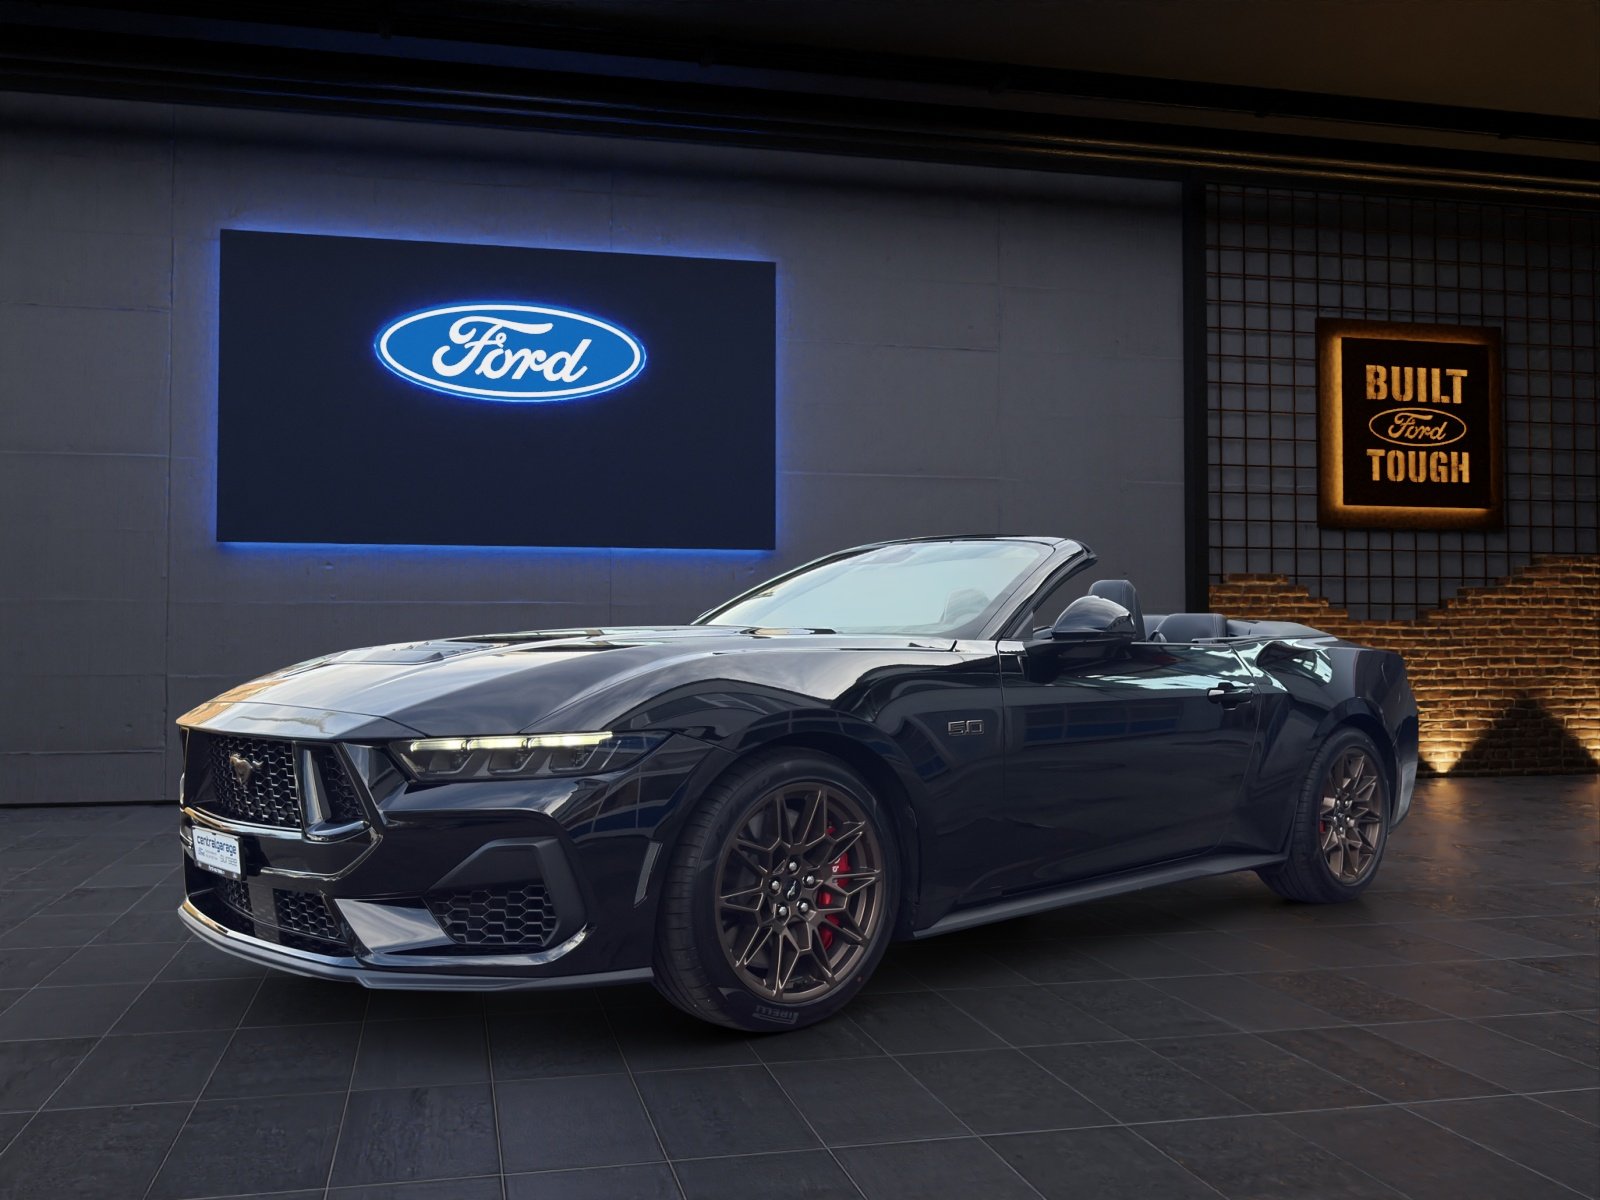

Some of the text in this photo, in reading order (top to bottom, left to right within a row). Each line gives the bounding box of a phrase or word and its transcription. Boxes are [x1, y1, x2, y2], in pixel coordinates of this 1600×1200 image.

[431, 315, 593, 383] Ford
[1365, 364, 1468, 404] BUILT
[1388, 412, 1448, 440] Ford
[1366, 448, 1470, 483] TOUGH
[196, 835, 237, 857] centralgarage
